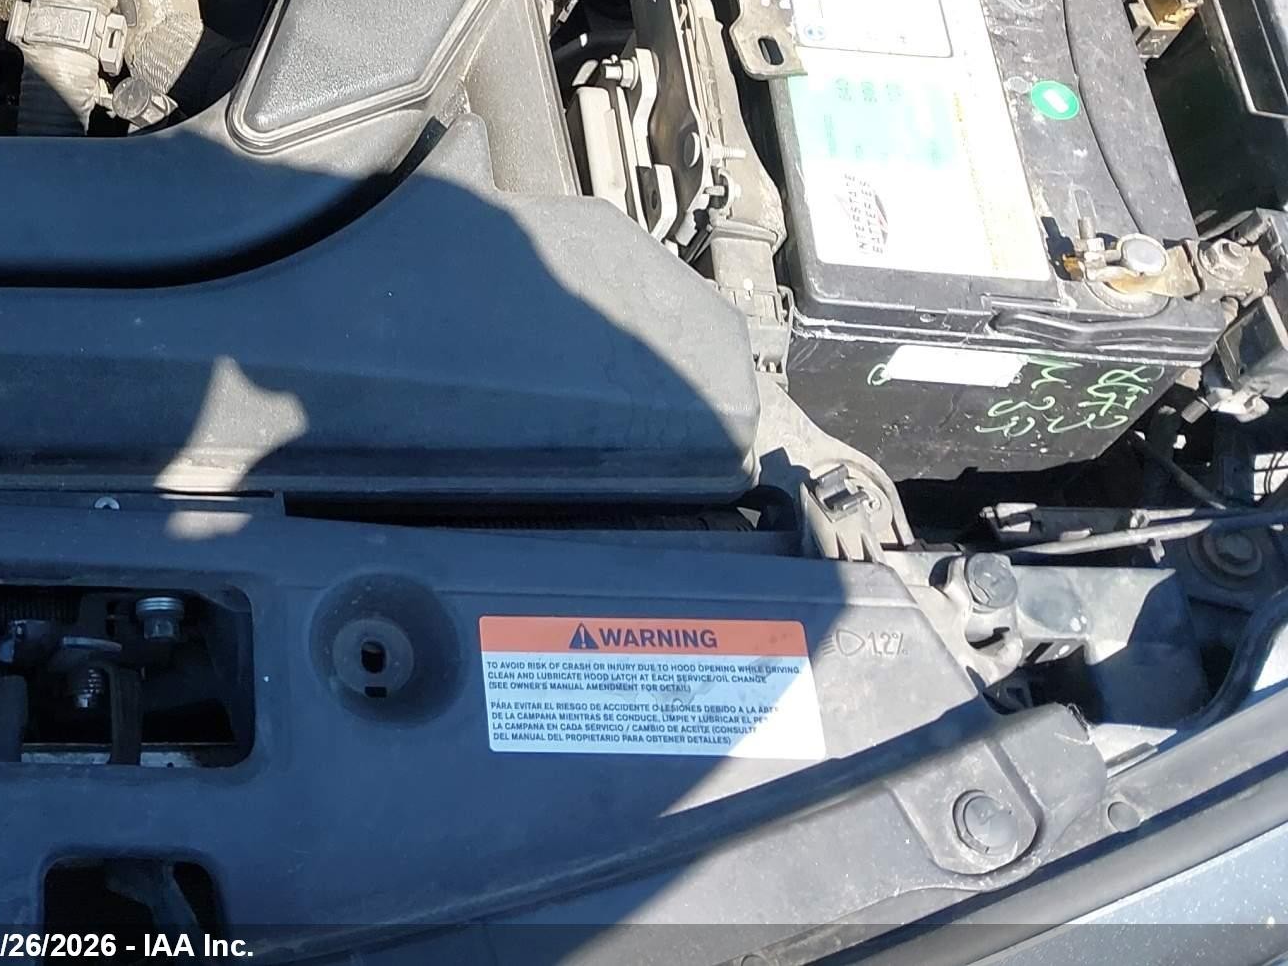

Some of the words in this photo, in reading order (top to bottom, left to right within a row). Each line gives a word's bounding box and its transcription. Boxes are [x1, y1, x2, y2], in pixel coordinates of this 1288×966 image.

[599, 628, 718, 648] WARNING
[658, 664, 668, 672] TO
[698, 665, 735, 673] OPENING
[739, 666, 763, 674] WHILE
[537, 672, 581, 680] LUBRICATE
[611, 673, 637, 681] LATCH
[652, 674, 674, 682] EACH
[489, 682, 507, 690] (SEE
[510, 682, 547, 690] OWNER'S
[586, 683, 638, 691] AMENDMENT
[660, 684, 691, 692] DETAIL)
[660, 705, 701, 713] LESIONES
[699, 715, 739, 723] LUBRICAR
[742, 716, 752, 724] EL
[560, 723, 582, 731] CADA
[668, 725, 678, 733] DE
[512, 733, 545, 741] MANUAL
[566, 734, 620, 742] PROPIETARIO
[623, 734, 644, 742] PARA
[646, 735, 685, 744] OBTENER
[688, 736, 731, 745] DETALLES)
